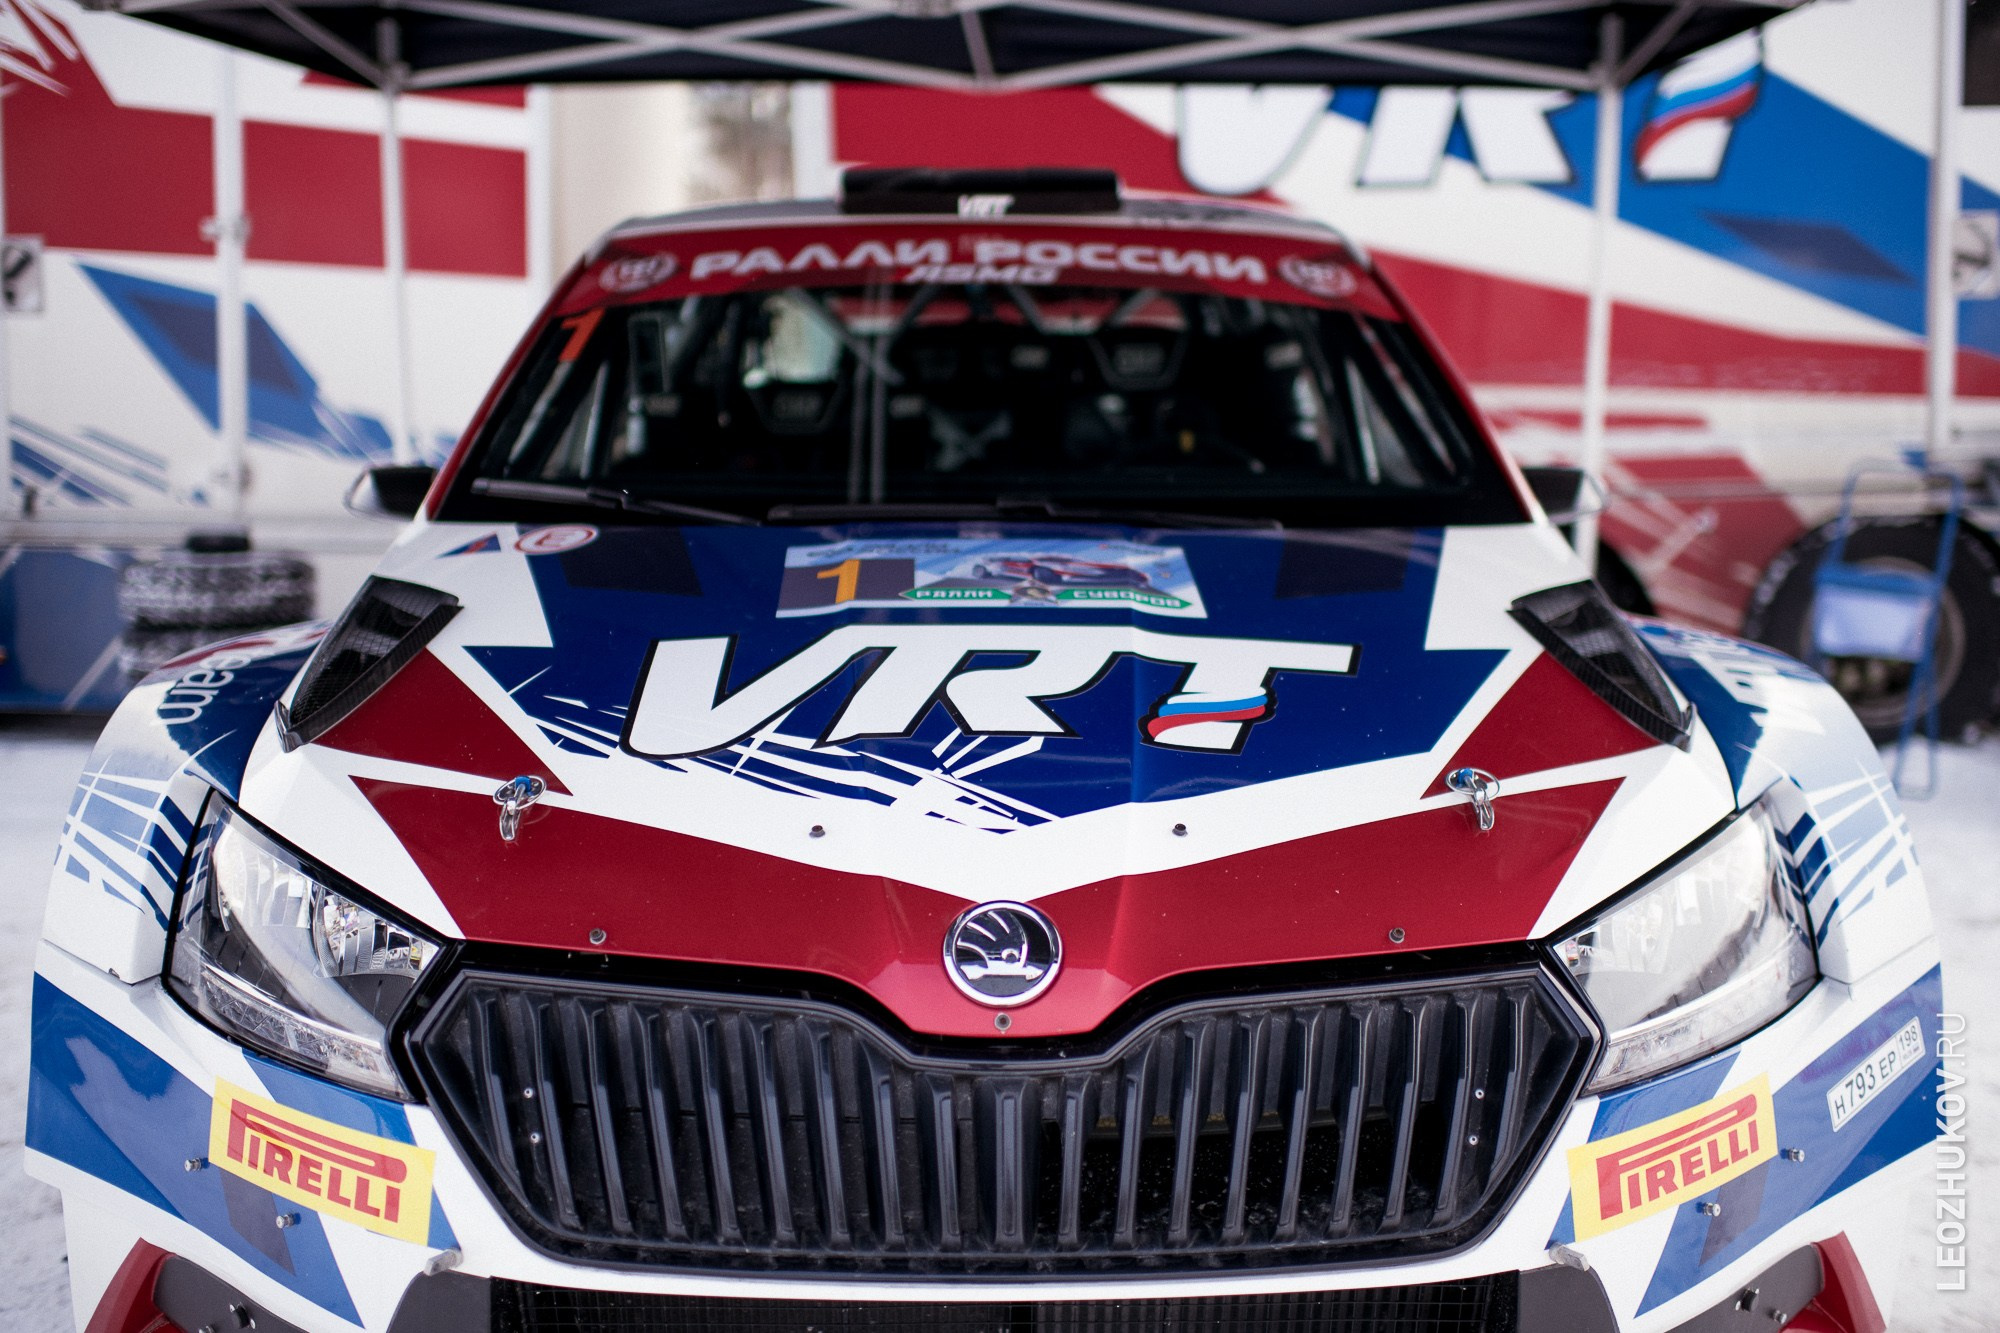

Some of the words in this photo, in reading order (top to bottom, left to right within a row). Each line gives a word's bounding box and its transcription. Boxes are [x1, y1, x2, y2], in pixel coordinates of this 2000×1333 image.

[957, 194, 1015, 220] VRT
[690, 240, 951, 281] РАЛЛИ
[973, 239, 1267, 285] РОССИИ
[556, 307, 606, 363] 1
[816, 558, 861, 604] 1
[916, 590, 994, 599] РАЛЛИ
[1072, 589, 1182, 608] СУВОРОВ
[618, 624, 1362, 758] VRT
[1845, 1064, 1876, 1107] 793
[1899, 1025, 1918, 1051] 198
[226, 1098, 408, 1224] PIRELLI
[1596, 1094, 1760, 1221] PIRELLI
